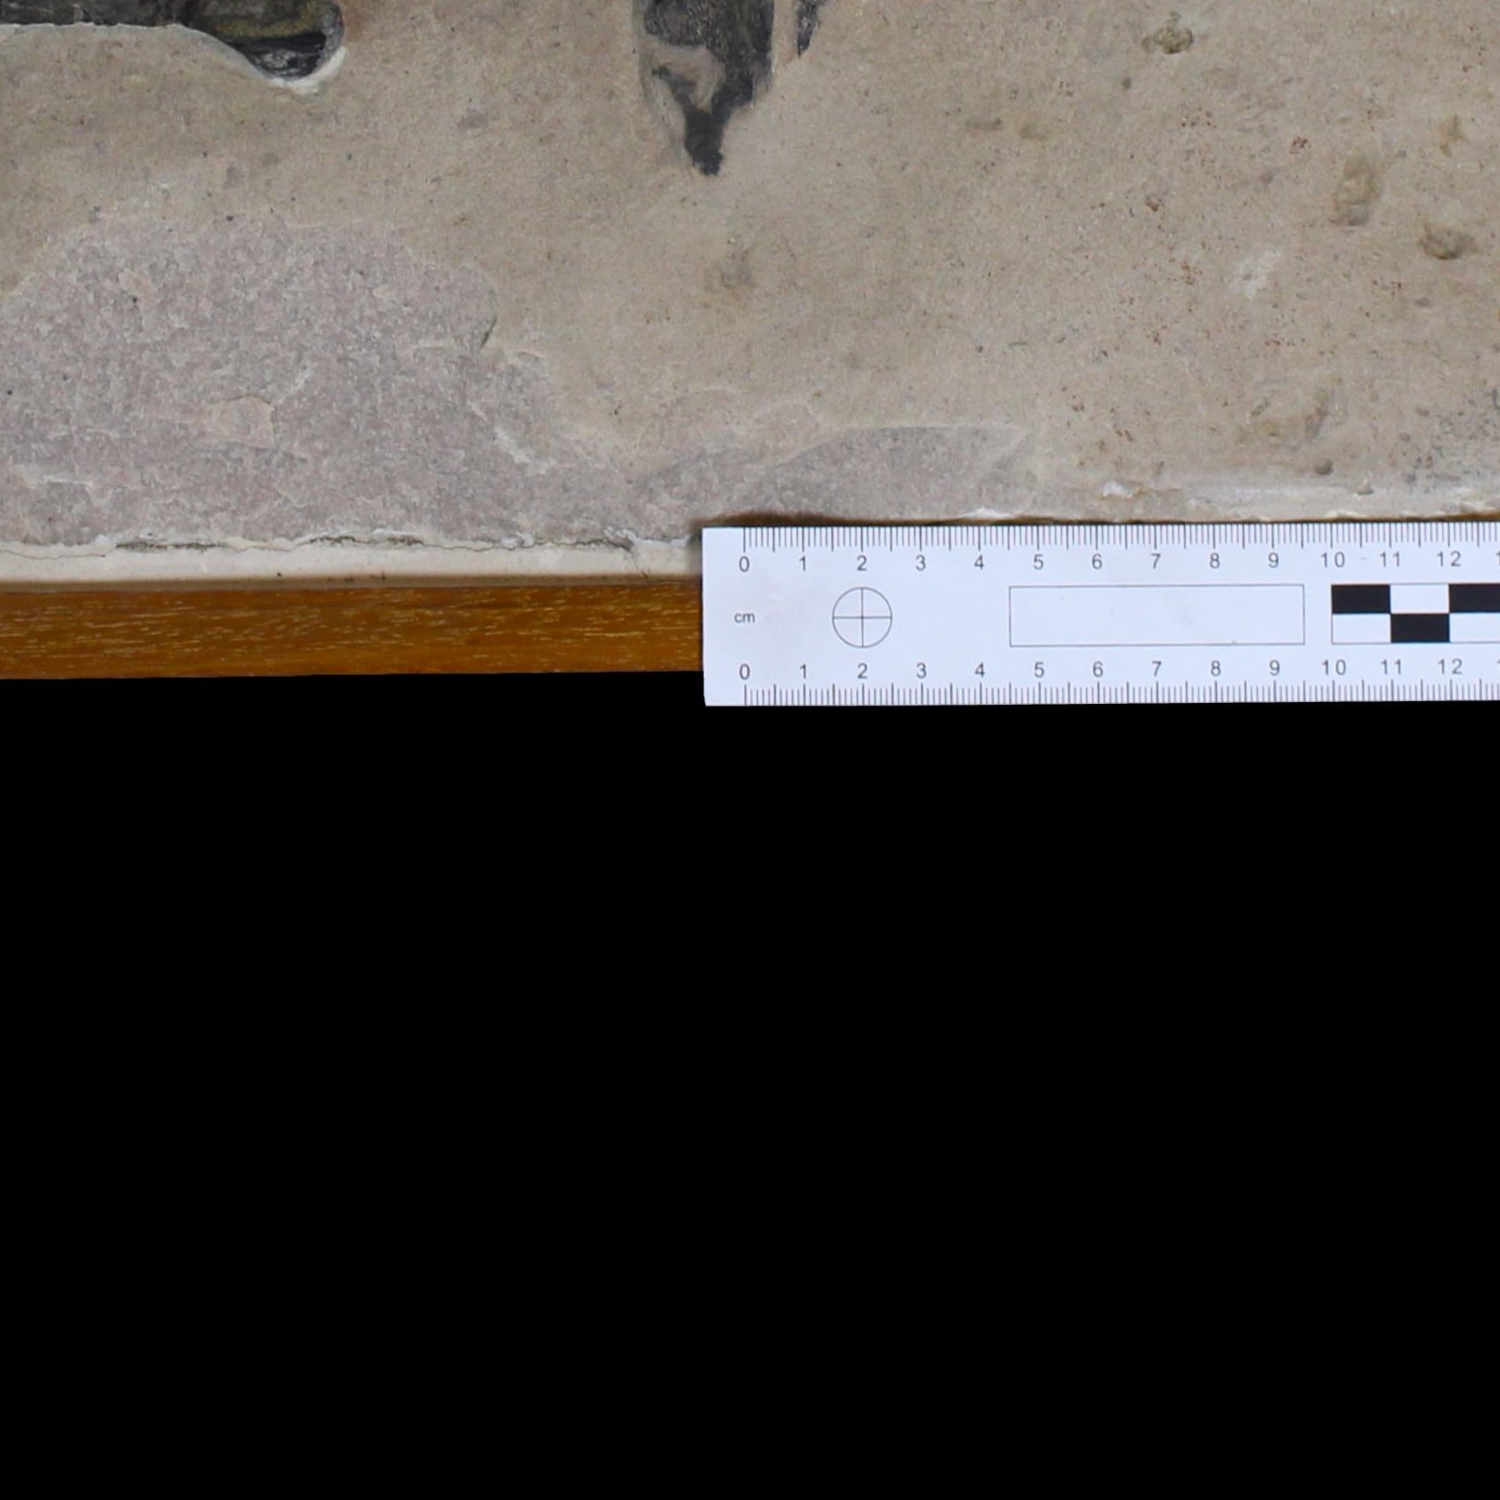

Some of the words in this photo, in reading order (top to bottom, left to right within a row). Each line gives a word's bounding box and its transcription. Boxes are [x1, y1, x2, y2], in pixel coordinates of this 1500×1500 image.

[739, 556, 750, 572] 0
[800, 556, 806, 571] 1
[857, 555, 867, 571] 2
[916, 555, 926, 571] 3
[974, 555, 984, 570] 4
[1034, 554, 1044, 570] 5
[1092, 554, 1102, 569] 6
[1152, 553, 1160, 568] 7
[1210, 553, 1220, 568] 8
[1268, 552, 1279, 568] 9
[1322, 552, 1345, 568] 10
[1380, 552, 1399, 566] 11
[1438, 551, 1461, 566] 12
[734, 614, 755, 623] cm
[739, 664, 750, 680] 0
[800, 664, 806, 679] 1
[858, 663, 868, 679] 2
[917, 662, 926, 679] 3
[975, 662, 985, 678] 4
[1034, 662, 1044, 678] 5
[1093, 662, 1103, 678] 6
[1152, 661, 1162, 676] 7
[1211, 660, 1221, 676] 8
[1270, 660, 1280, 676] 9
[1323, 660, 1346, 675] 10
[1382, 660, 1401, 674] 11
[1438, 659, 1462, 674] 12
